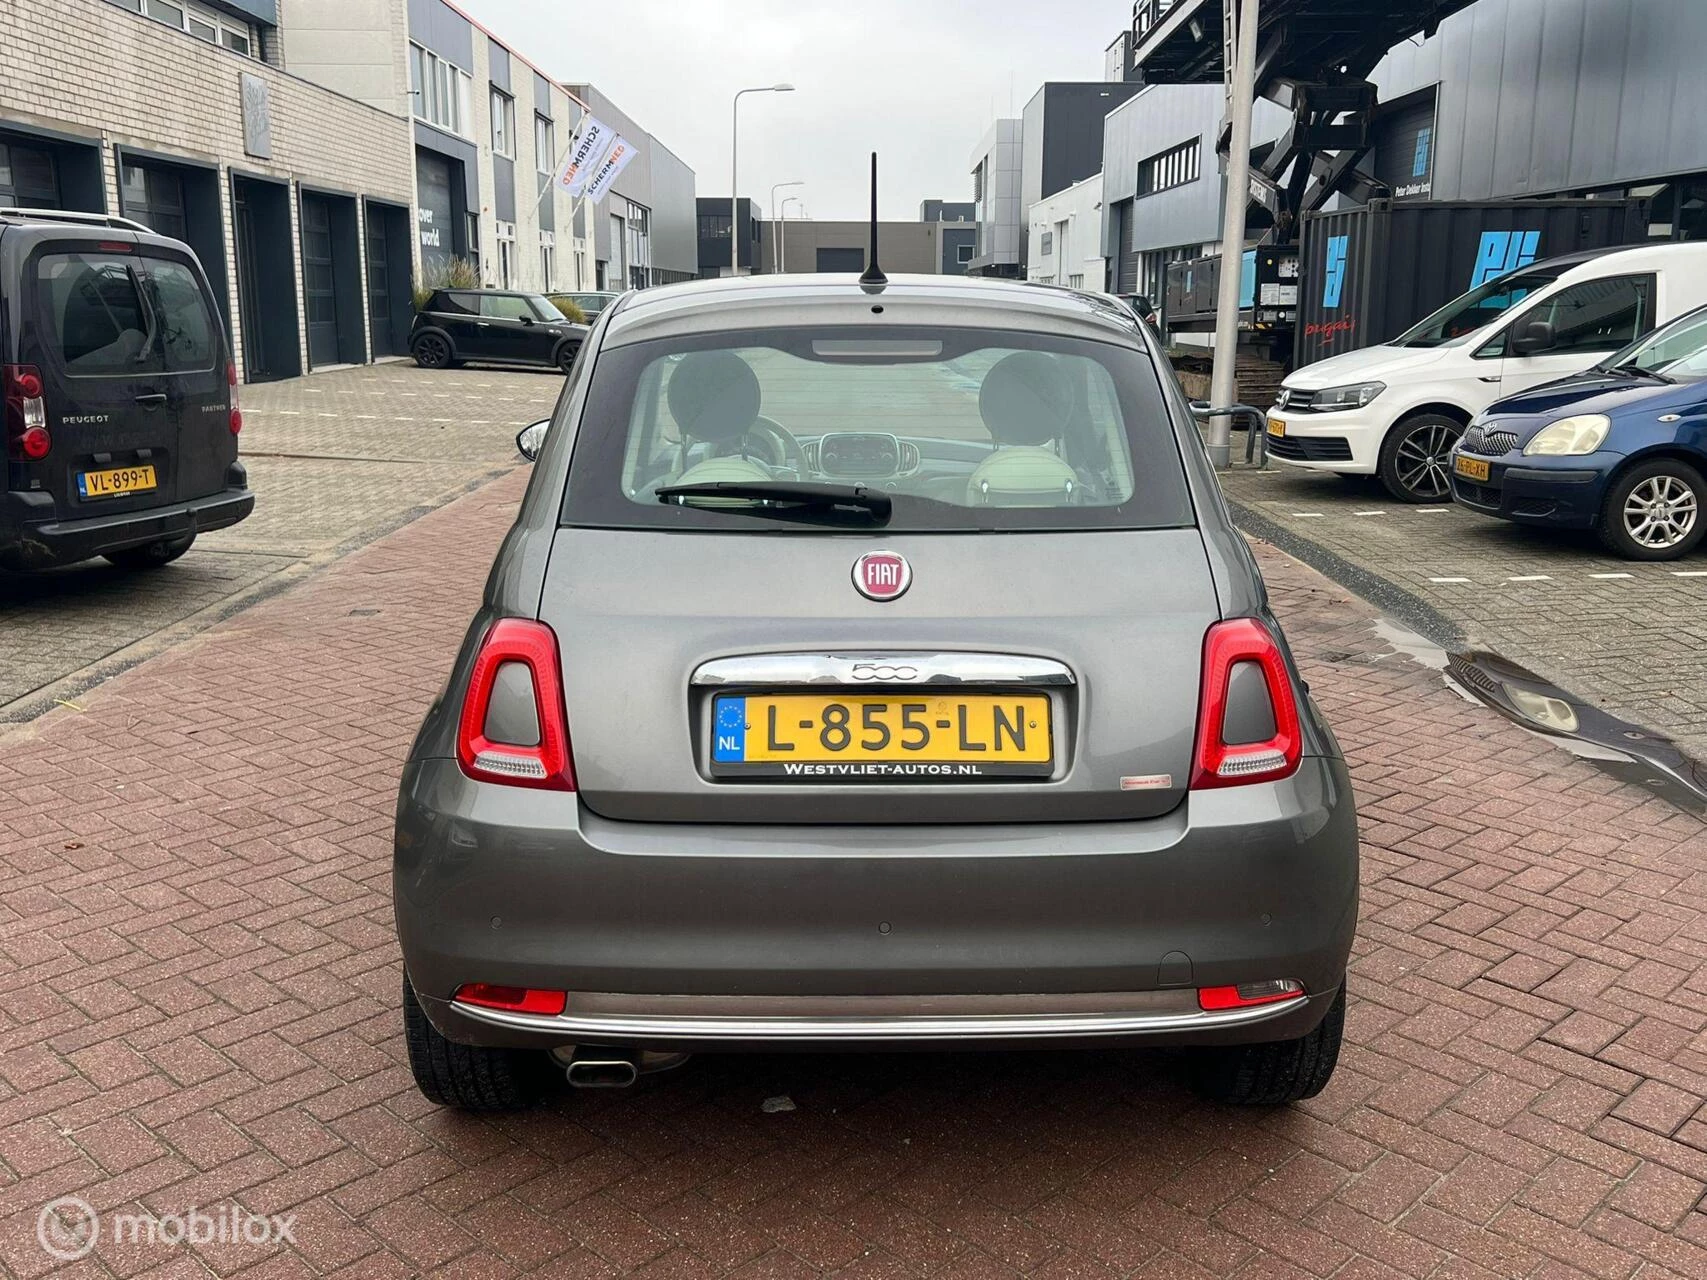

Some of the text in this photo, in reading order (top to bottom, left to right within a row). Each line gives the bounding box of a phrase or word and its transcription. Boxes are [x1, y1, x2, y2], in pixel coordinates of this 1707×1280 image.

[201, 404, 226, 412] PARTNER
[62, 414, 109, 424] PEUGEOT
[90, 468, 149, 492] VL-899-T
[867, 563, 900, 585] FIAT
[851, 663, 918, 681] 500
[719, 703, 1026, 752] NL L-855-LN
